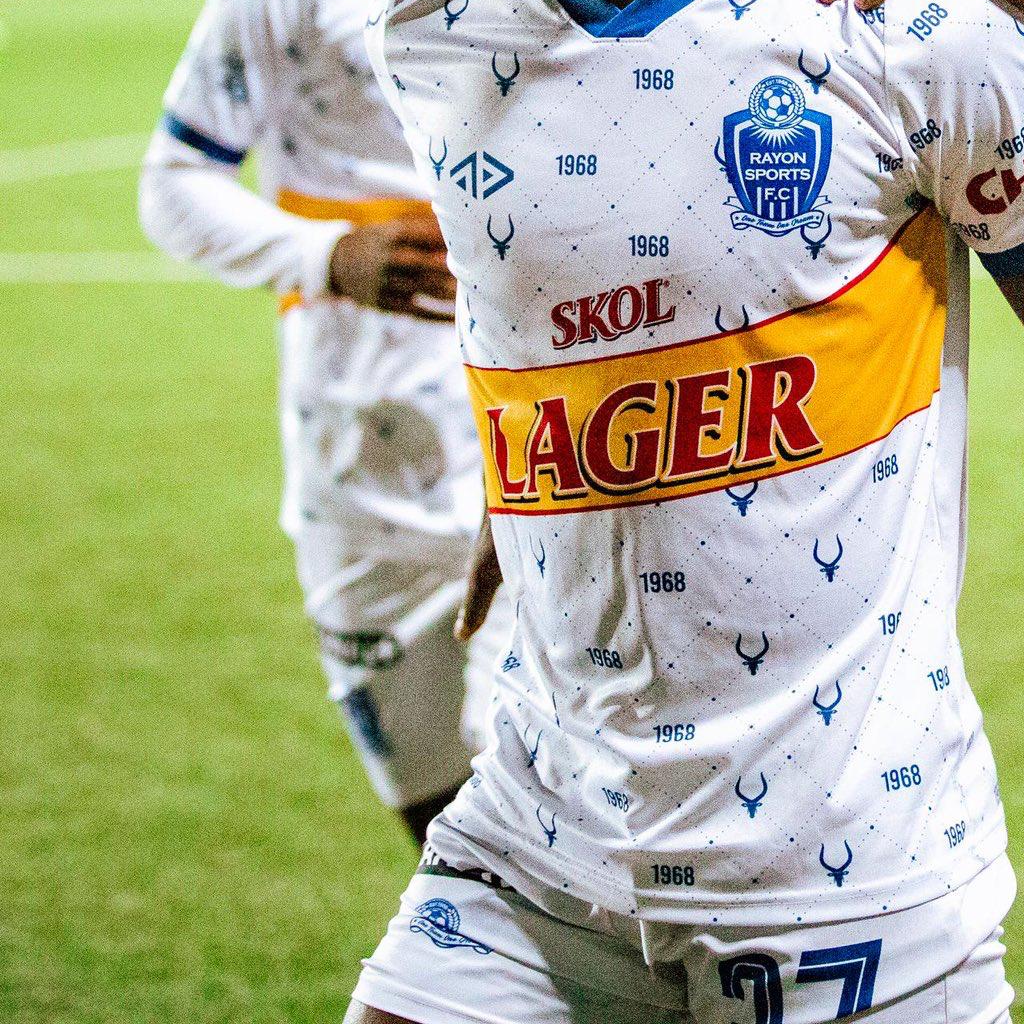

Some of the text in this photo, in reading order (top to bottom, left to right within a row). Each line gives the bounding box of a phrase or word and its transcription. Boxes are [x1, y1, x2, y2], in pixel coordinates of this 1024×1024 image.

[907, 3, 948, 42] 1968
[632, 68, 674, 91] 1968
[555, 154, 598, 176] 1968
[750, 152, 807, 164] RAYON
[745, 169, 811, 181] SPORTS
[764, 187, 791, 200] F.C
[628, 235, 670, 257] 1968
[551, 279, 676, 350] SKOL
[486, 355, 824, 503] LAGER
[872, 454, 899, 483] 1968
[640, 571, 686, 594] 1968
[586, 647, 623, 670] 1968
[653, 724, 695, 743] 1968
[881, 764, 922, 792] 1968
[650, 865, 695, 887] 1968
